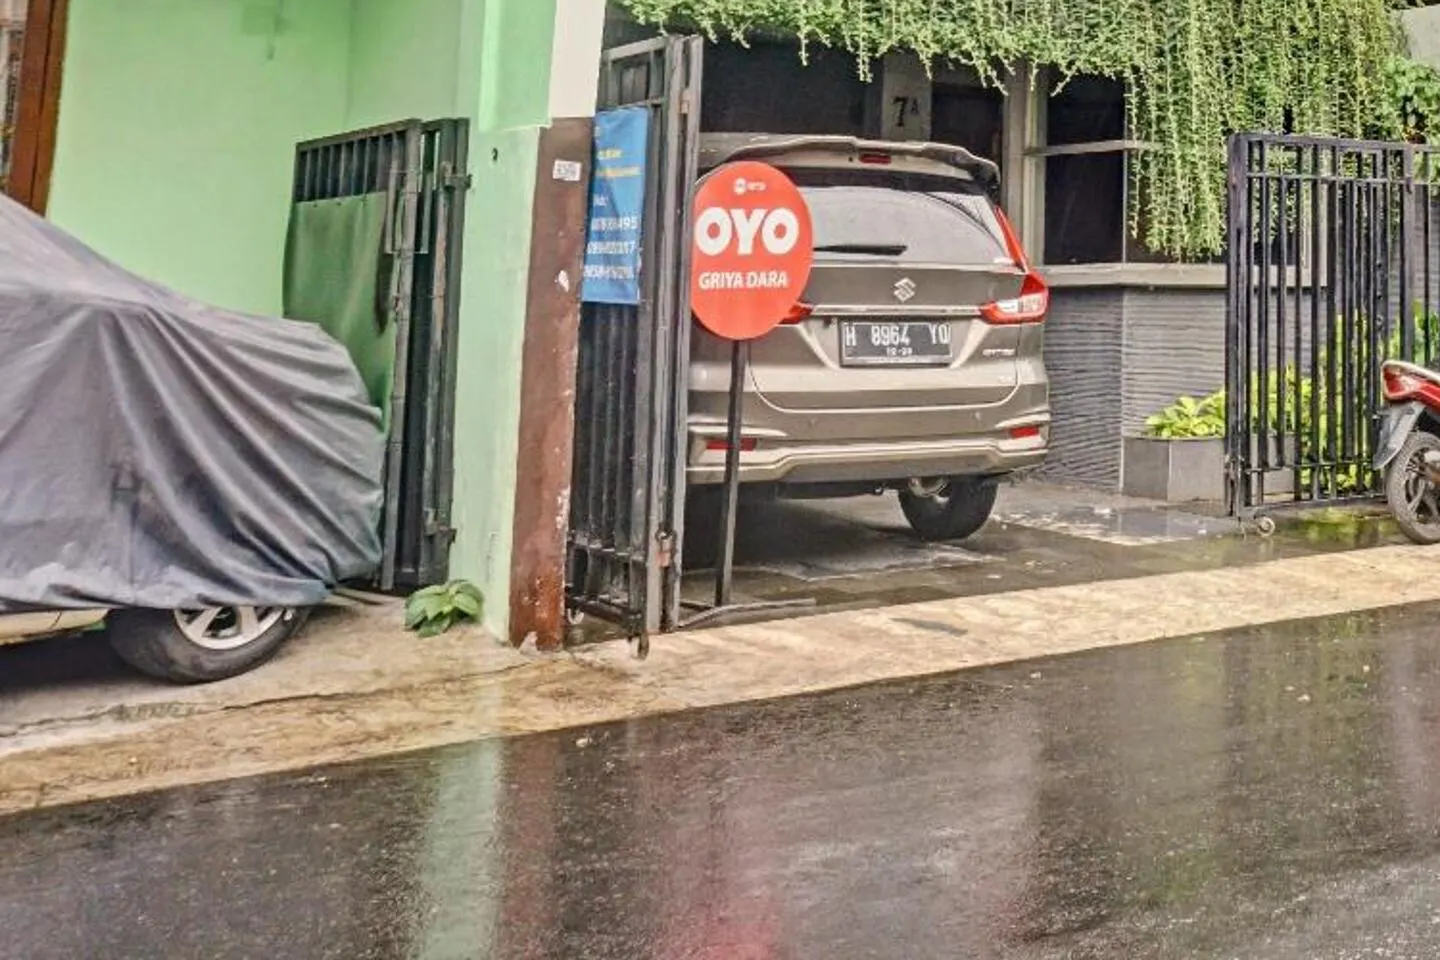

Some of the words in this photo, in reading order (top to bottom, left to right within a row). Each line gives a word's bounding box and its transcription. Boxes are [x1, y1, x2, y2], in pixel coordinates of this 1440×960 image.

[695, 207, 799, 256] OYO
[699, 271, 743, 290] GRIYA
[746, 270, 788, 289] DARA
[846, 325, 857, 346] H
[871, 324, 911, 346] 8964
